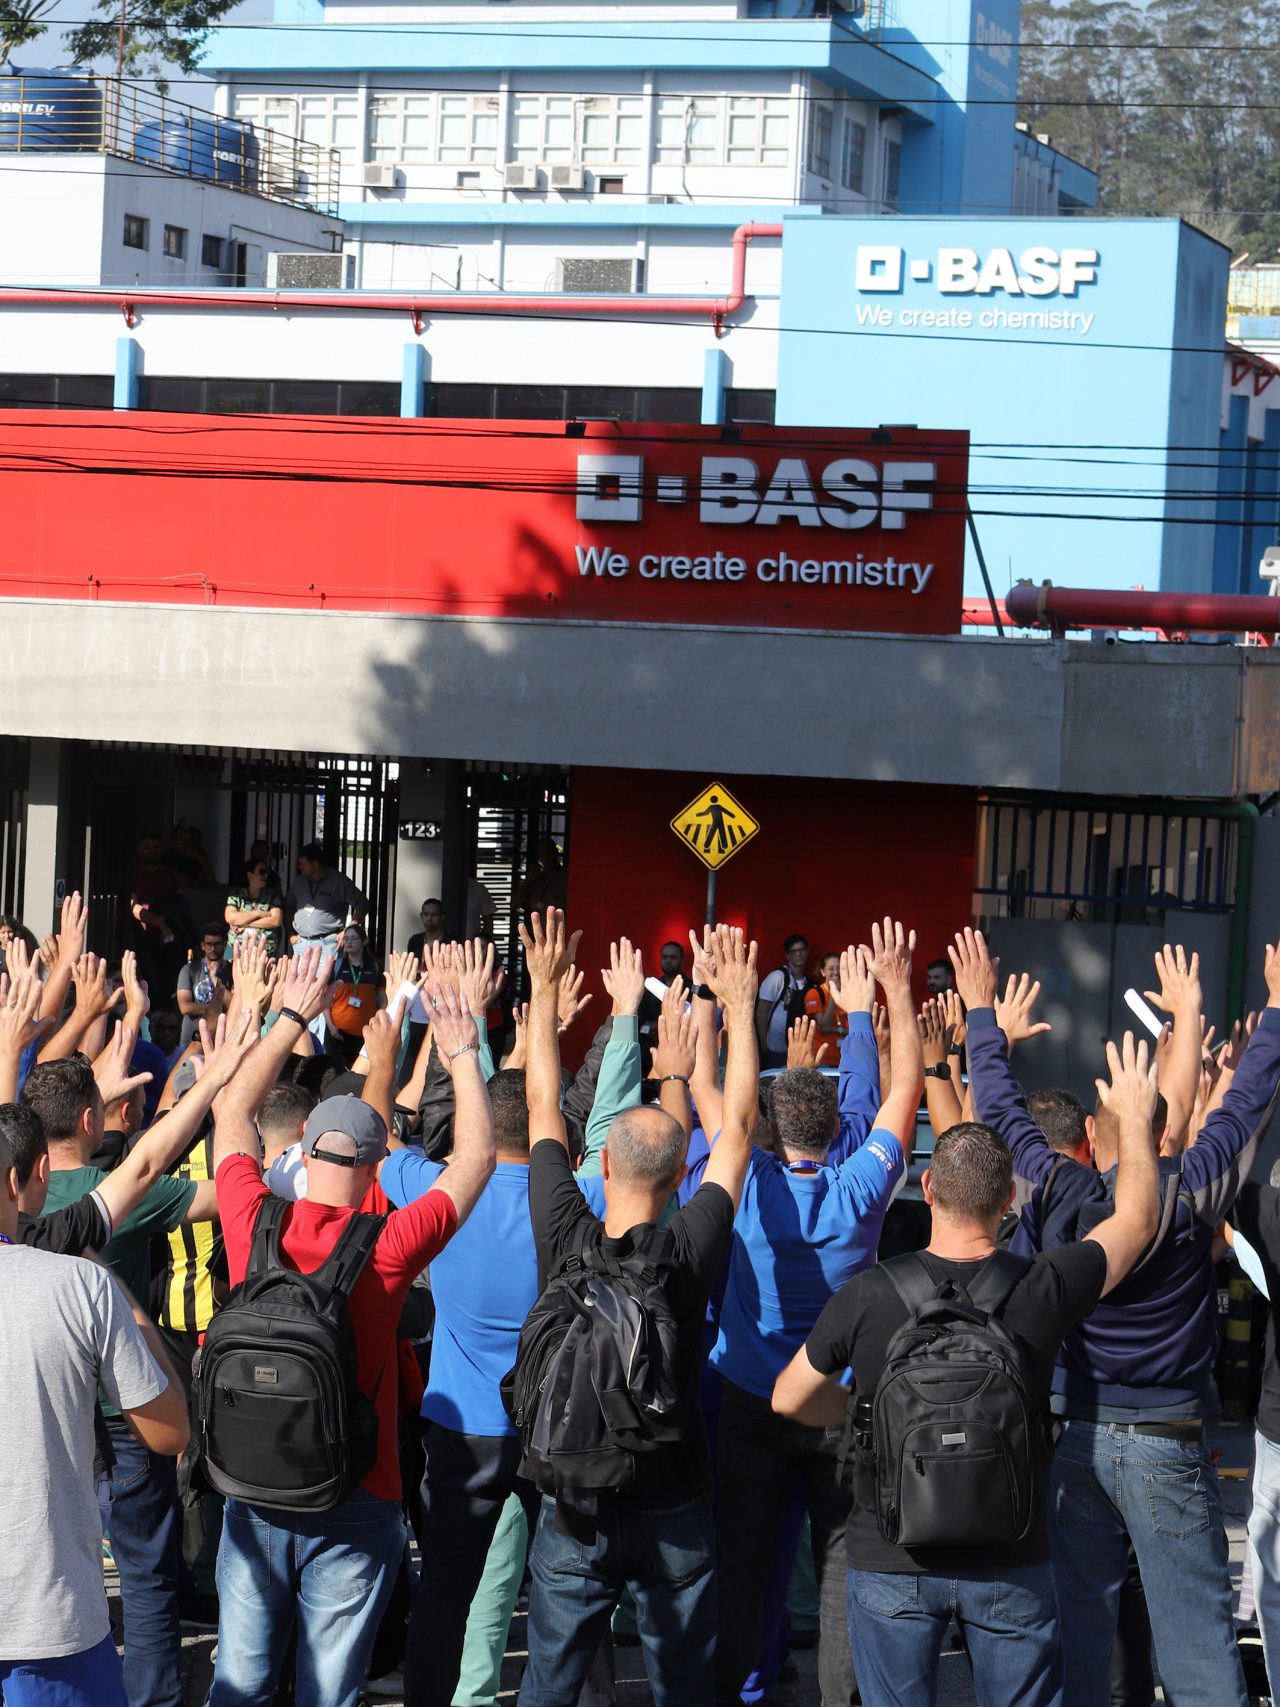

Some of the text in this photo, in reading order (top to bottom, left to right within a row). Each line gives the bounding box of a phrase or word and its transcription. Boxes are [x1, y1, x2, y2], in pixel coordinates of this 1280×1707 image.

[938, 246, 1099, 296] BASF
[855, 303, 1095, 335] We create chemistry
[699, 456, 937, 530] BASF
[574, 545, 935, 594] We create chemistry
[405, 822, 436, 838] 123
